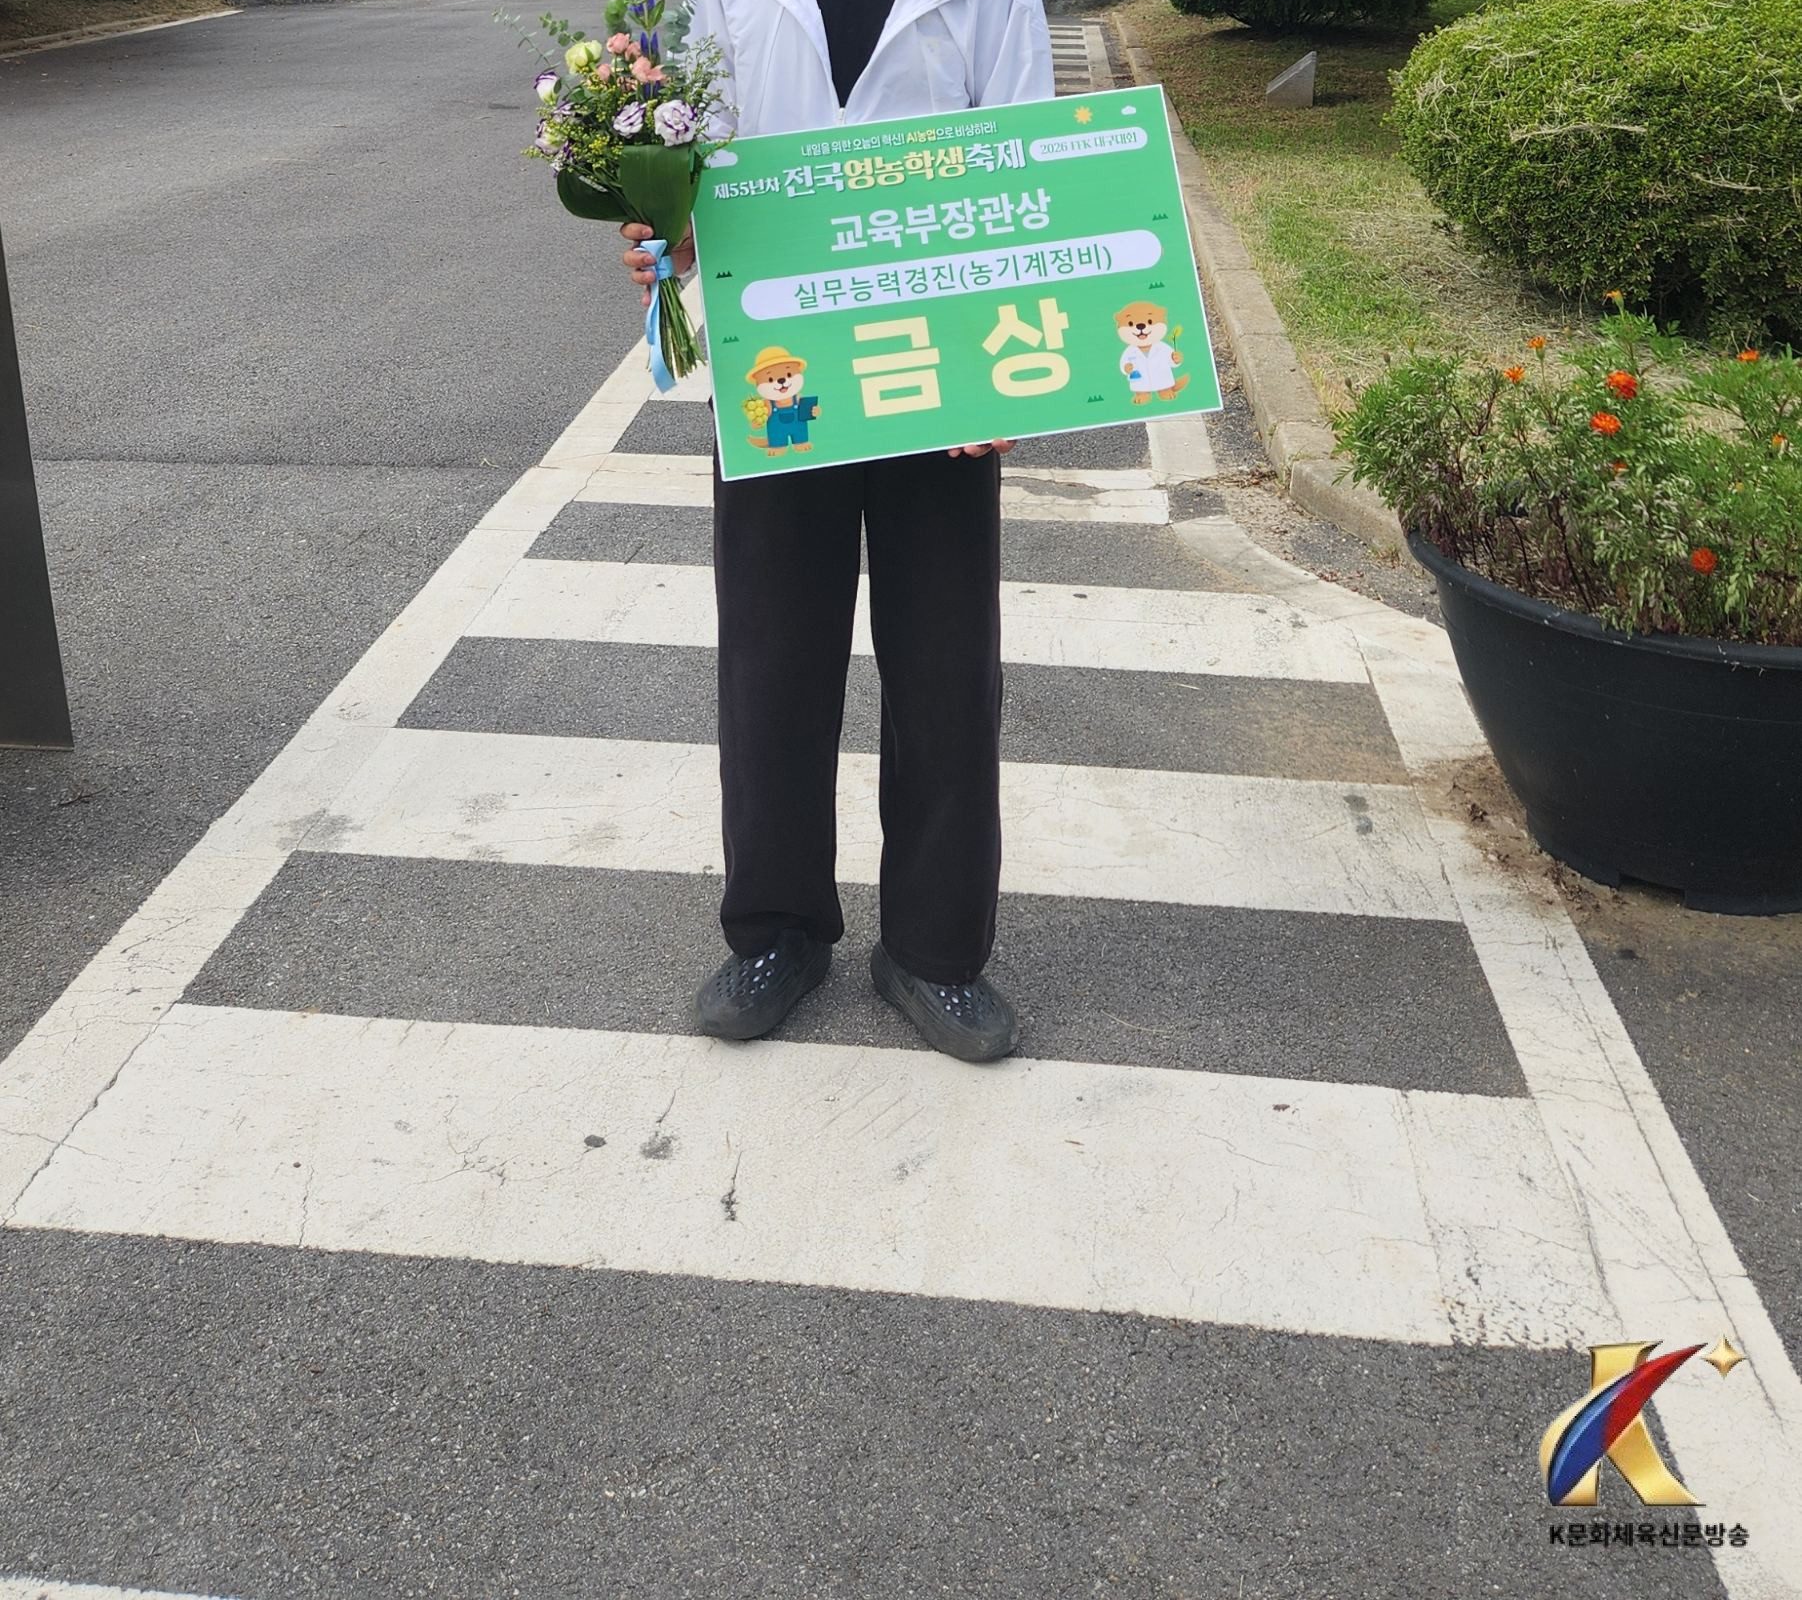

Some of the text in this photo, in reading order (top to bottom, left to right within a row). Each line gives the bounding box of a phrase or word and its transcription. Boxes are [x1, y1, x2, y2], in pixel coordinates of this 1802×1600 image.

[713, 138, 1026, 200] 제55년차 전국영농학생축제
[801, 121, 998, 157] 내일을 위한 오늘의 혁신! AI농업으로 비상하라!
[1040, 141, 1068, 155] 2026
[830, 188, 1052, 251] 교육부장관상
[794, 244, 1113, 309] 실무능력경진(농기계정비)
